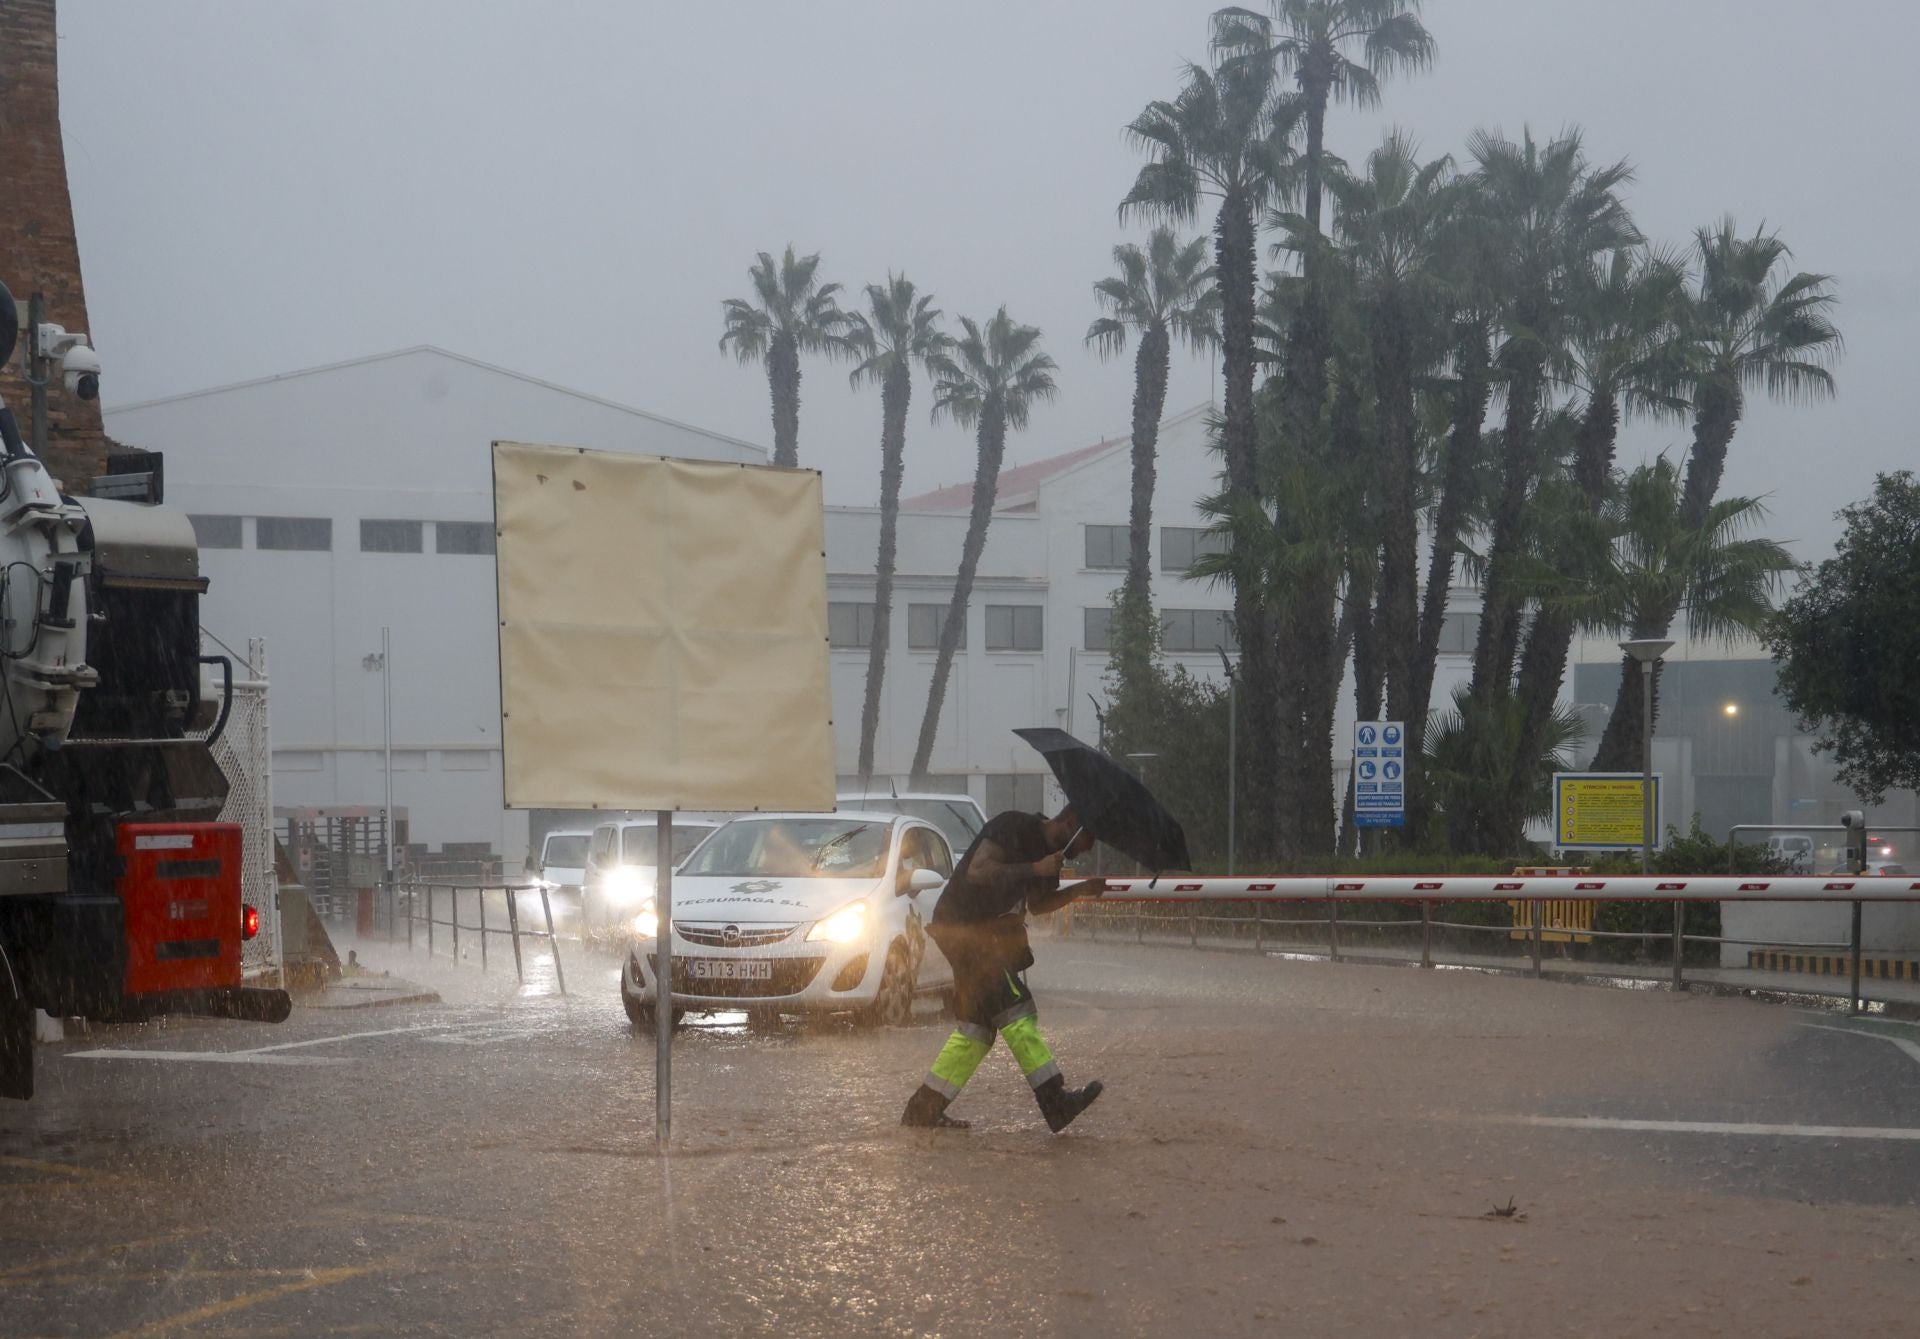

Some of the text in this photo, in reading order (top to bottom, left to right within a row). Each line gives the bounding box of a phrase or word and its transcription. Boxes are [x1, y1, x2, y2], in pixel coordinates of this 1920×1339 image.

[676, 896, 809, 908] TECSUMAGA S.L.
[697, 962, 734, 976] 5113
